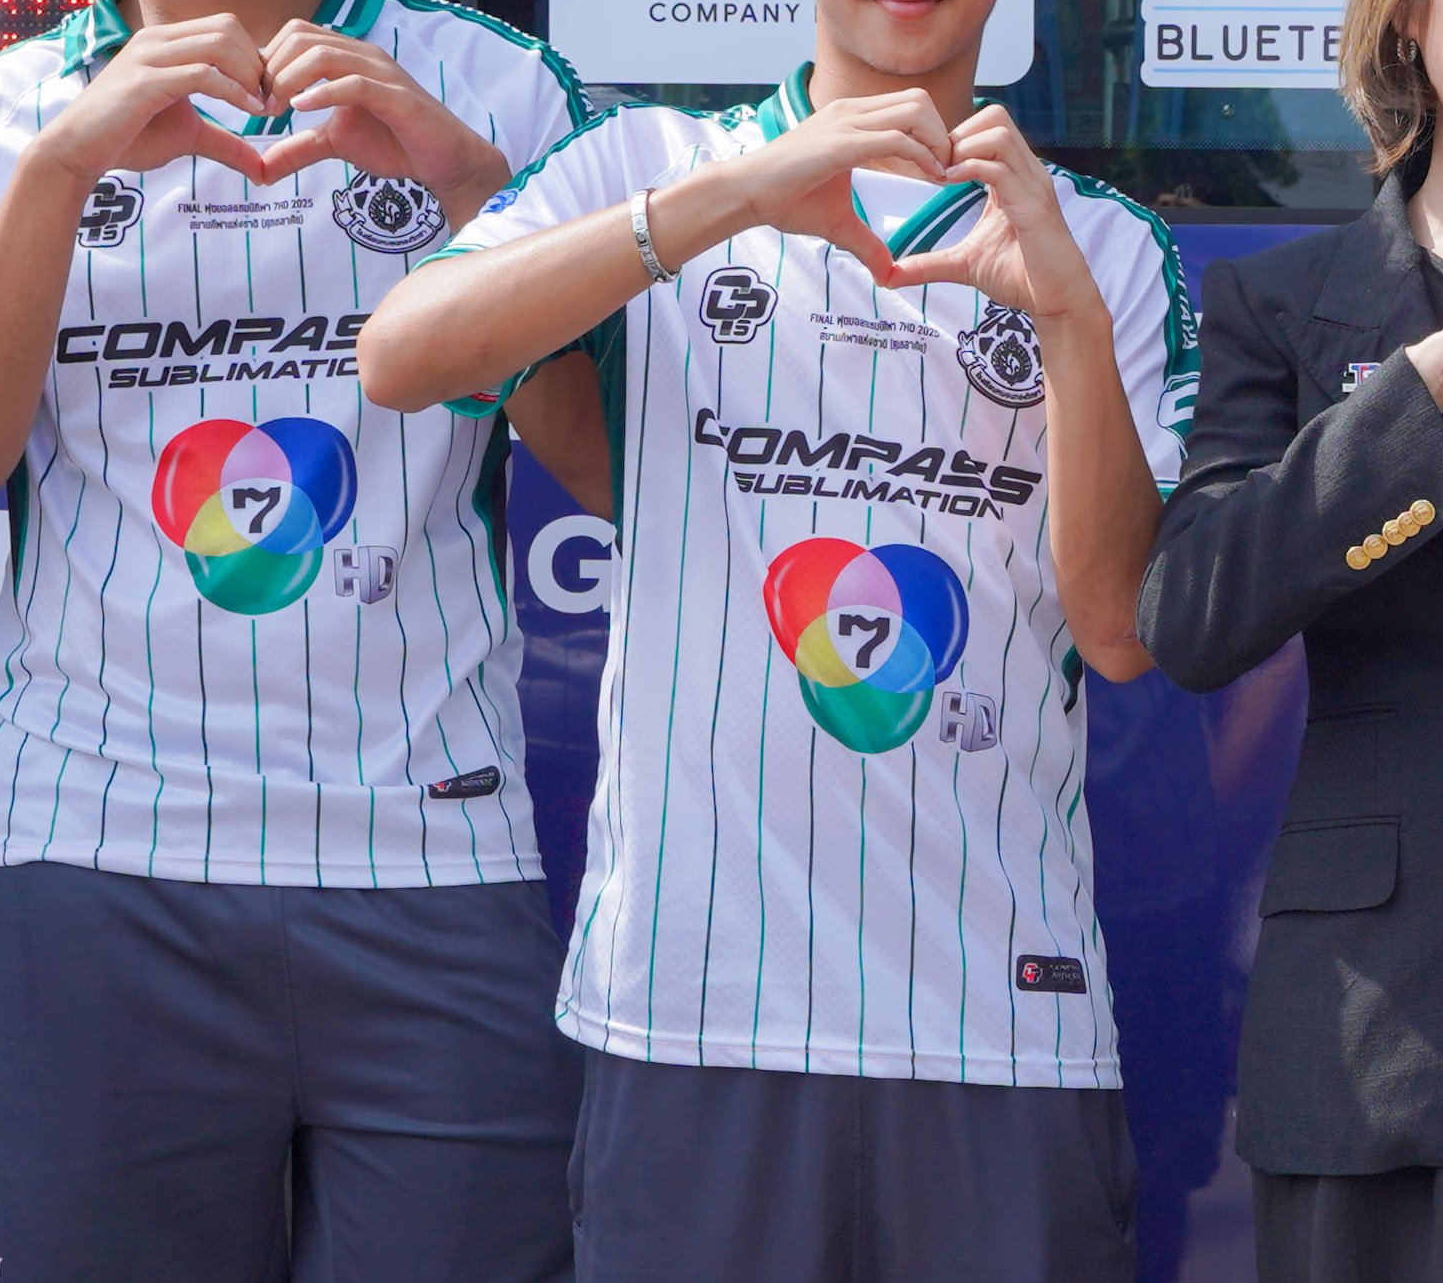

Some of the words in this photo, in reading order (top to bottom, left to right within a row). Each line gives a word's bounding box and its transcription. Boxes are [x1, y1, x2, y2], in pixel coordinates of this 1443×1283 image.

[649, 1, 801, 24] COMPANY
[178, 203, 202, 213] FINAL
[274, 200, 289, 210] 7HD
[291, 198, 314, 209] 2025
[810, 313, 834, 326] FINAL
[899, 321, 916, 333] 7HD
[918, 324, 940, 338] 2025
[694, 406, 1043, 507] COMPASS
[232, 486, 281, 535] 7
[733, 470, 1006, 522] SUBLIMATION
[332, 544, 400, 606] HD
[837, 612, 891, 670] 7
[939, 689, 998, 754] HD
